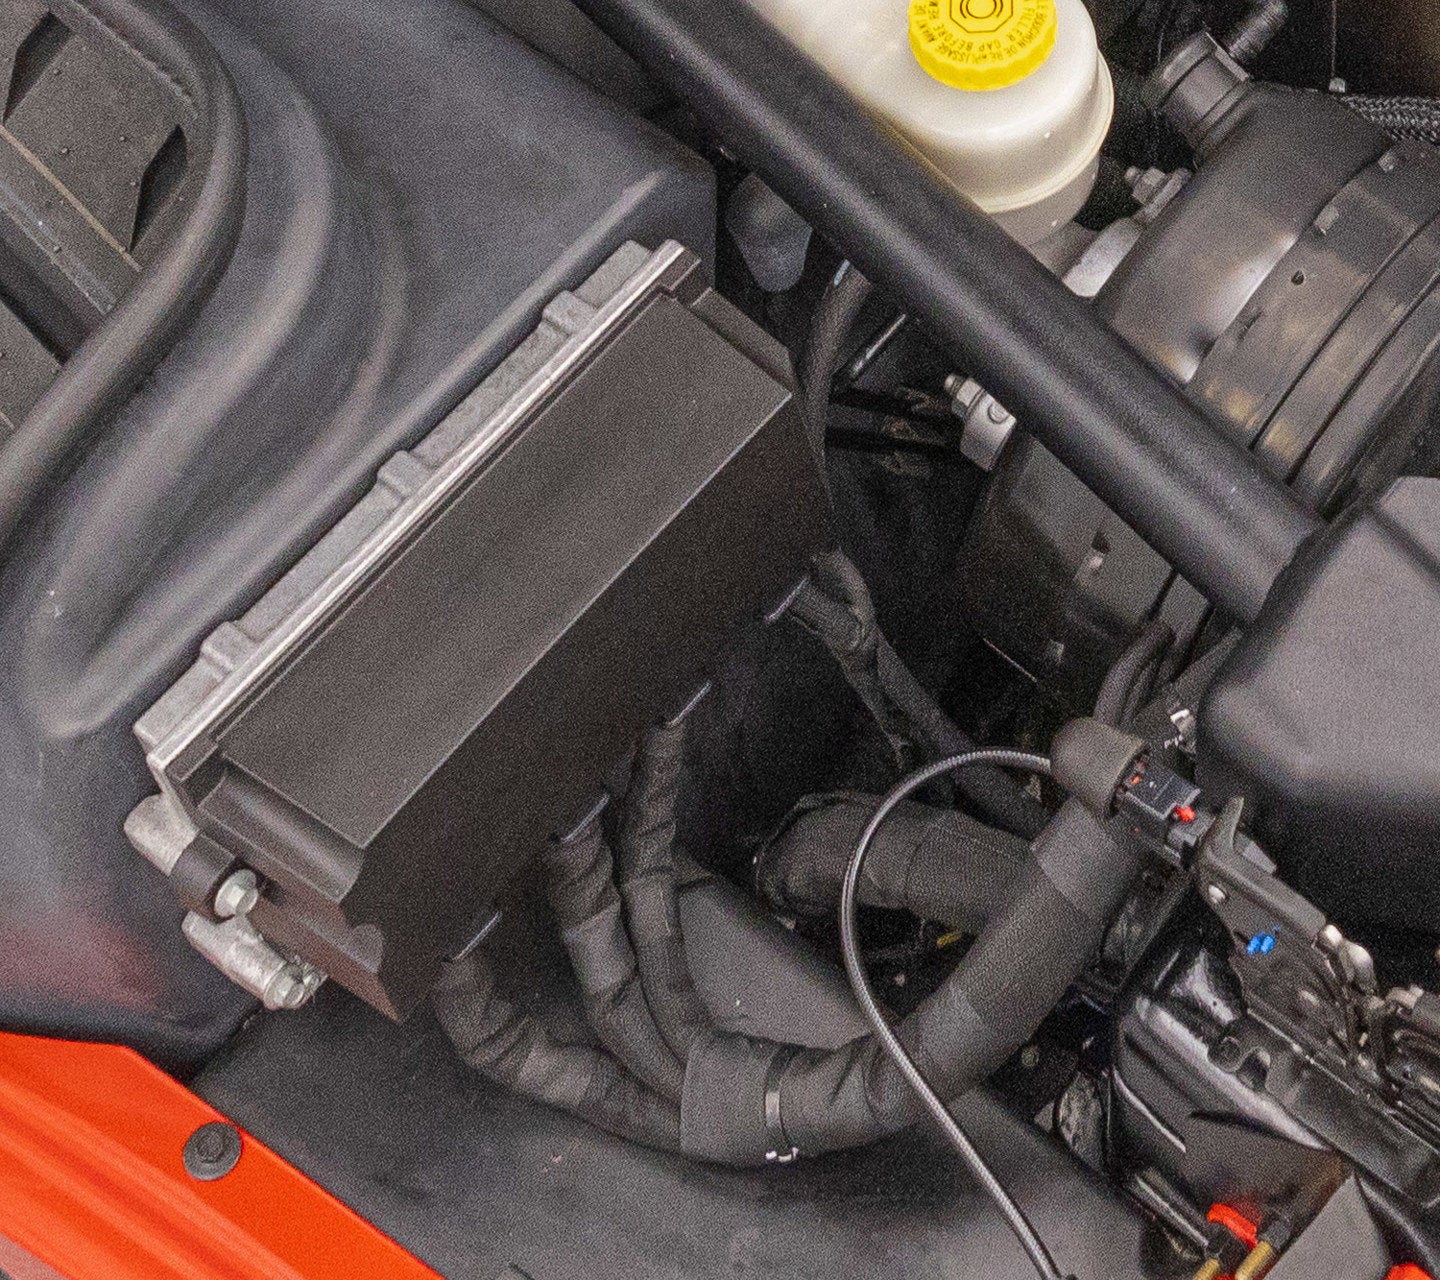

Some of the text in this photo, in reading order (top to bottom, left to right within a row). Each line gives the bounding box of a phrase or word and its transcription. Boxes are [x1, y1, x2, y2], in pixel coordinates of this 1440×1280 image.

[934, 23, 974, 51] BEFORE
[1007, 6, 1036, 41] FILLER
[979, 39, 1001, 53] CAP
